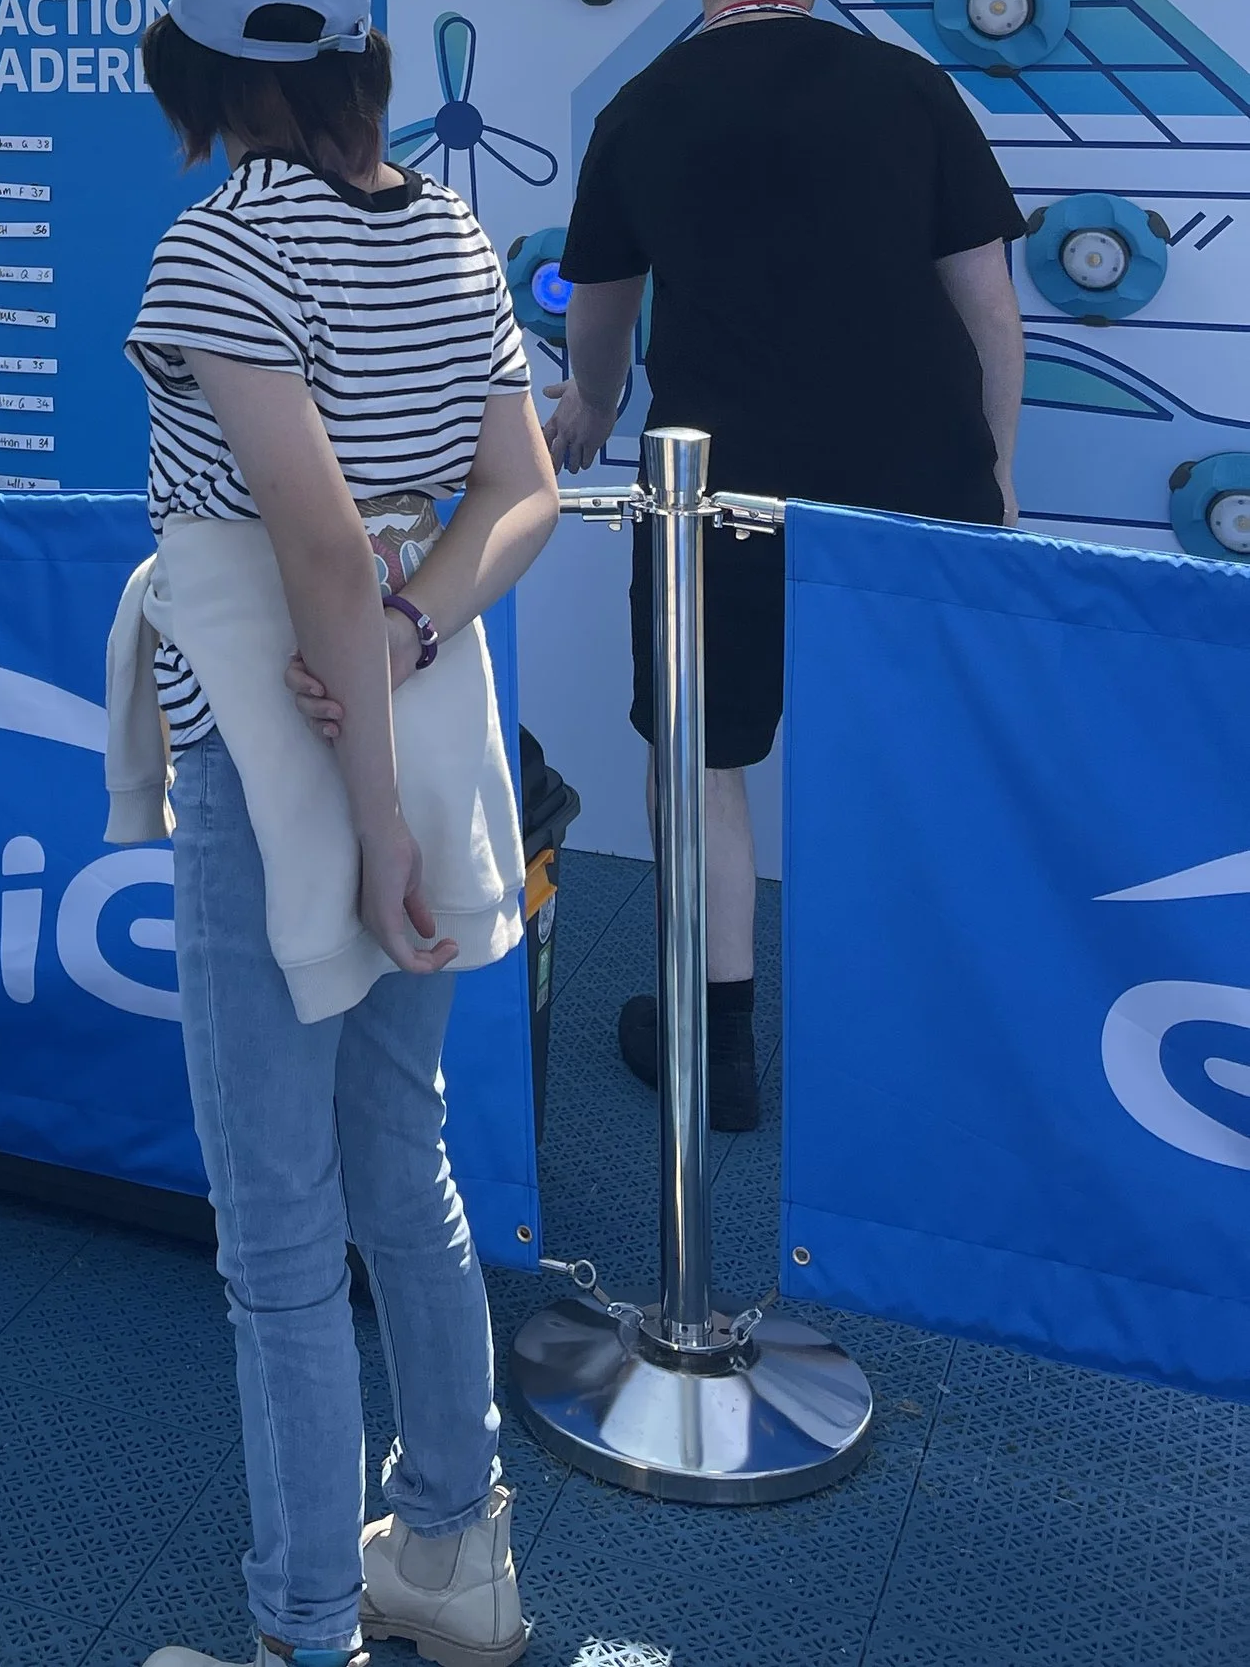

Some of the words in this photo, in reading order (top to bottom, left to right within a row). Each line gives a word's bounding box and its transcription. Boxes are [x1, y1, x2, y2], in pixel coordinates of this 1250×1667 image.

[36, 139, 50, 149] 38
[31, 187, 44, 198] 37
[32, 224, 48, 235] 36
[32, 360, 45, 370] 35
[36, 398, 50, 409] 34
[25, 438, 32, 449] H
